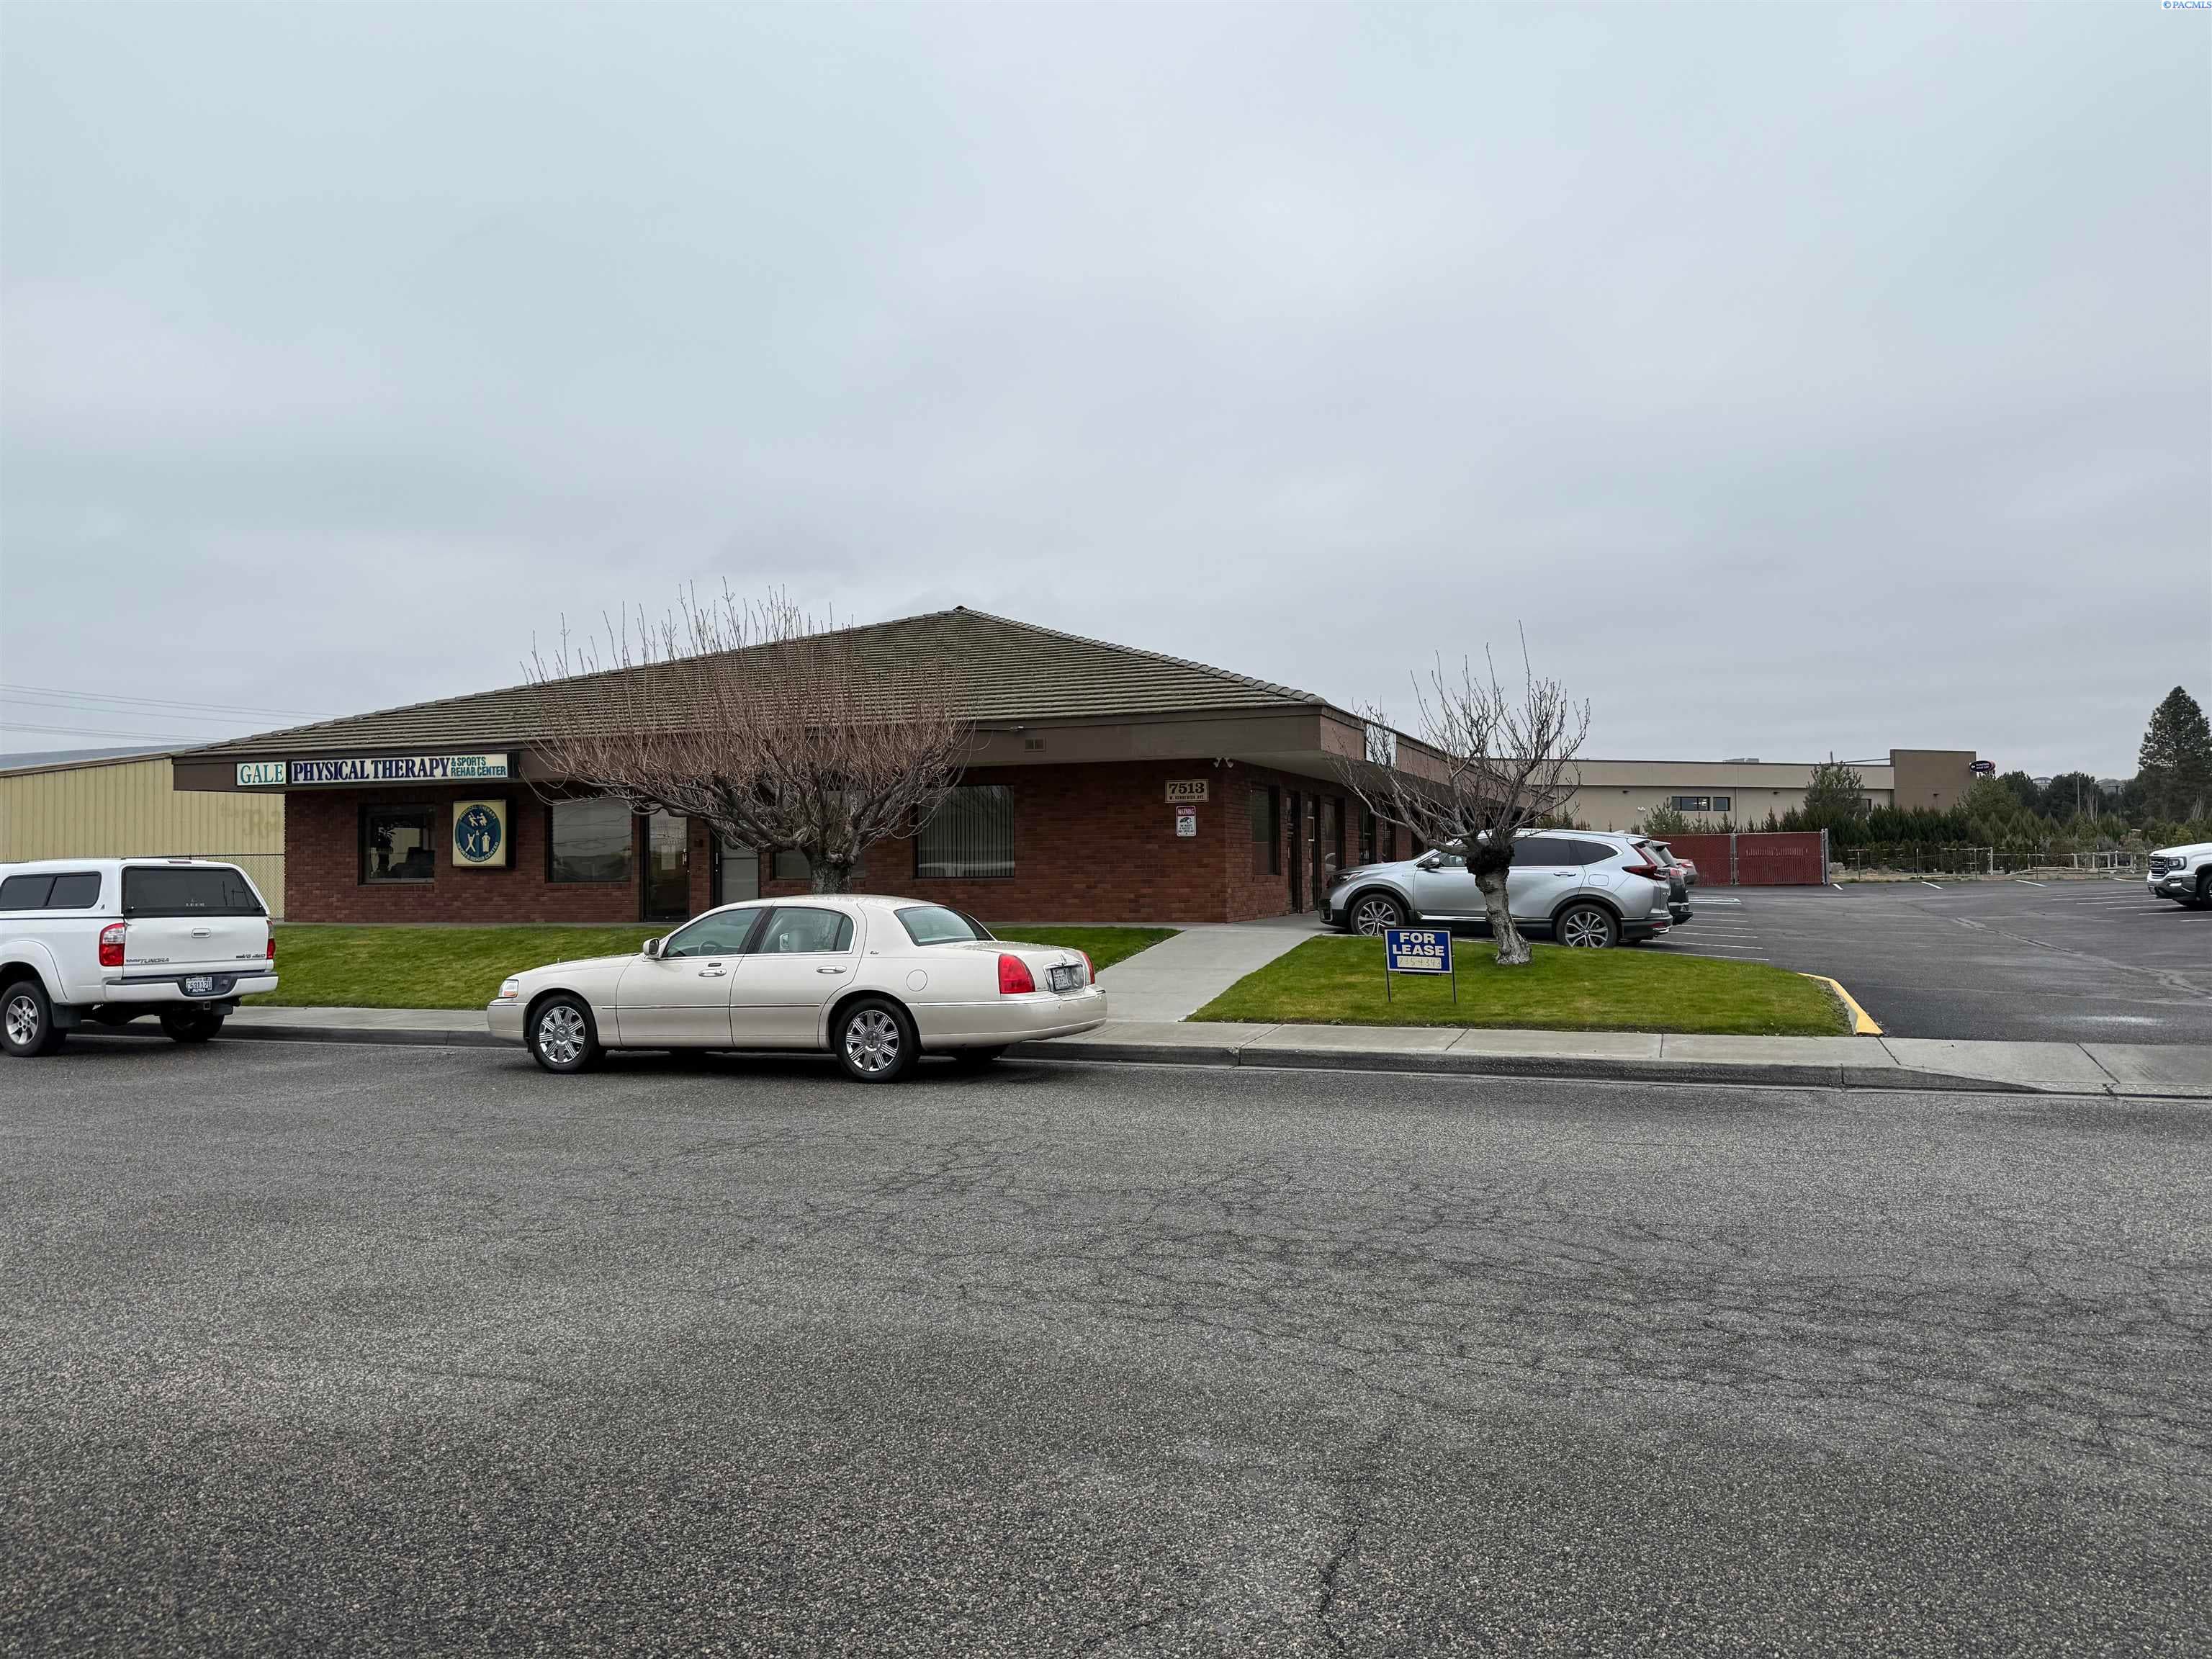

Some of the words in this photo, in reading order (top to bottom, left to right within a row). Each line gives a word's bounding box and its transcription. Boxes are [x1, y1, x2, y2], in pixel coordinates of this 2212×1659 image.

[451, 757, 457, 766] &
[457, 756, 486, 766] SPORTS
[240, 764, 284, 783] GALE
[292, 760, 369, 781] PHYSICAL
[371, 757, 450, 778] THERAPY
[451, 766, 475, 776] REHAB
[477, 766, 505, 776] CENTER
[1169, 783, 1205, 794] 7513
[1399, 932, 1436, 944] FOR
[1392, 944, 1444, 956] LEASE
